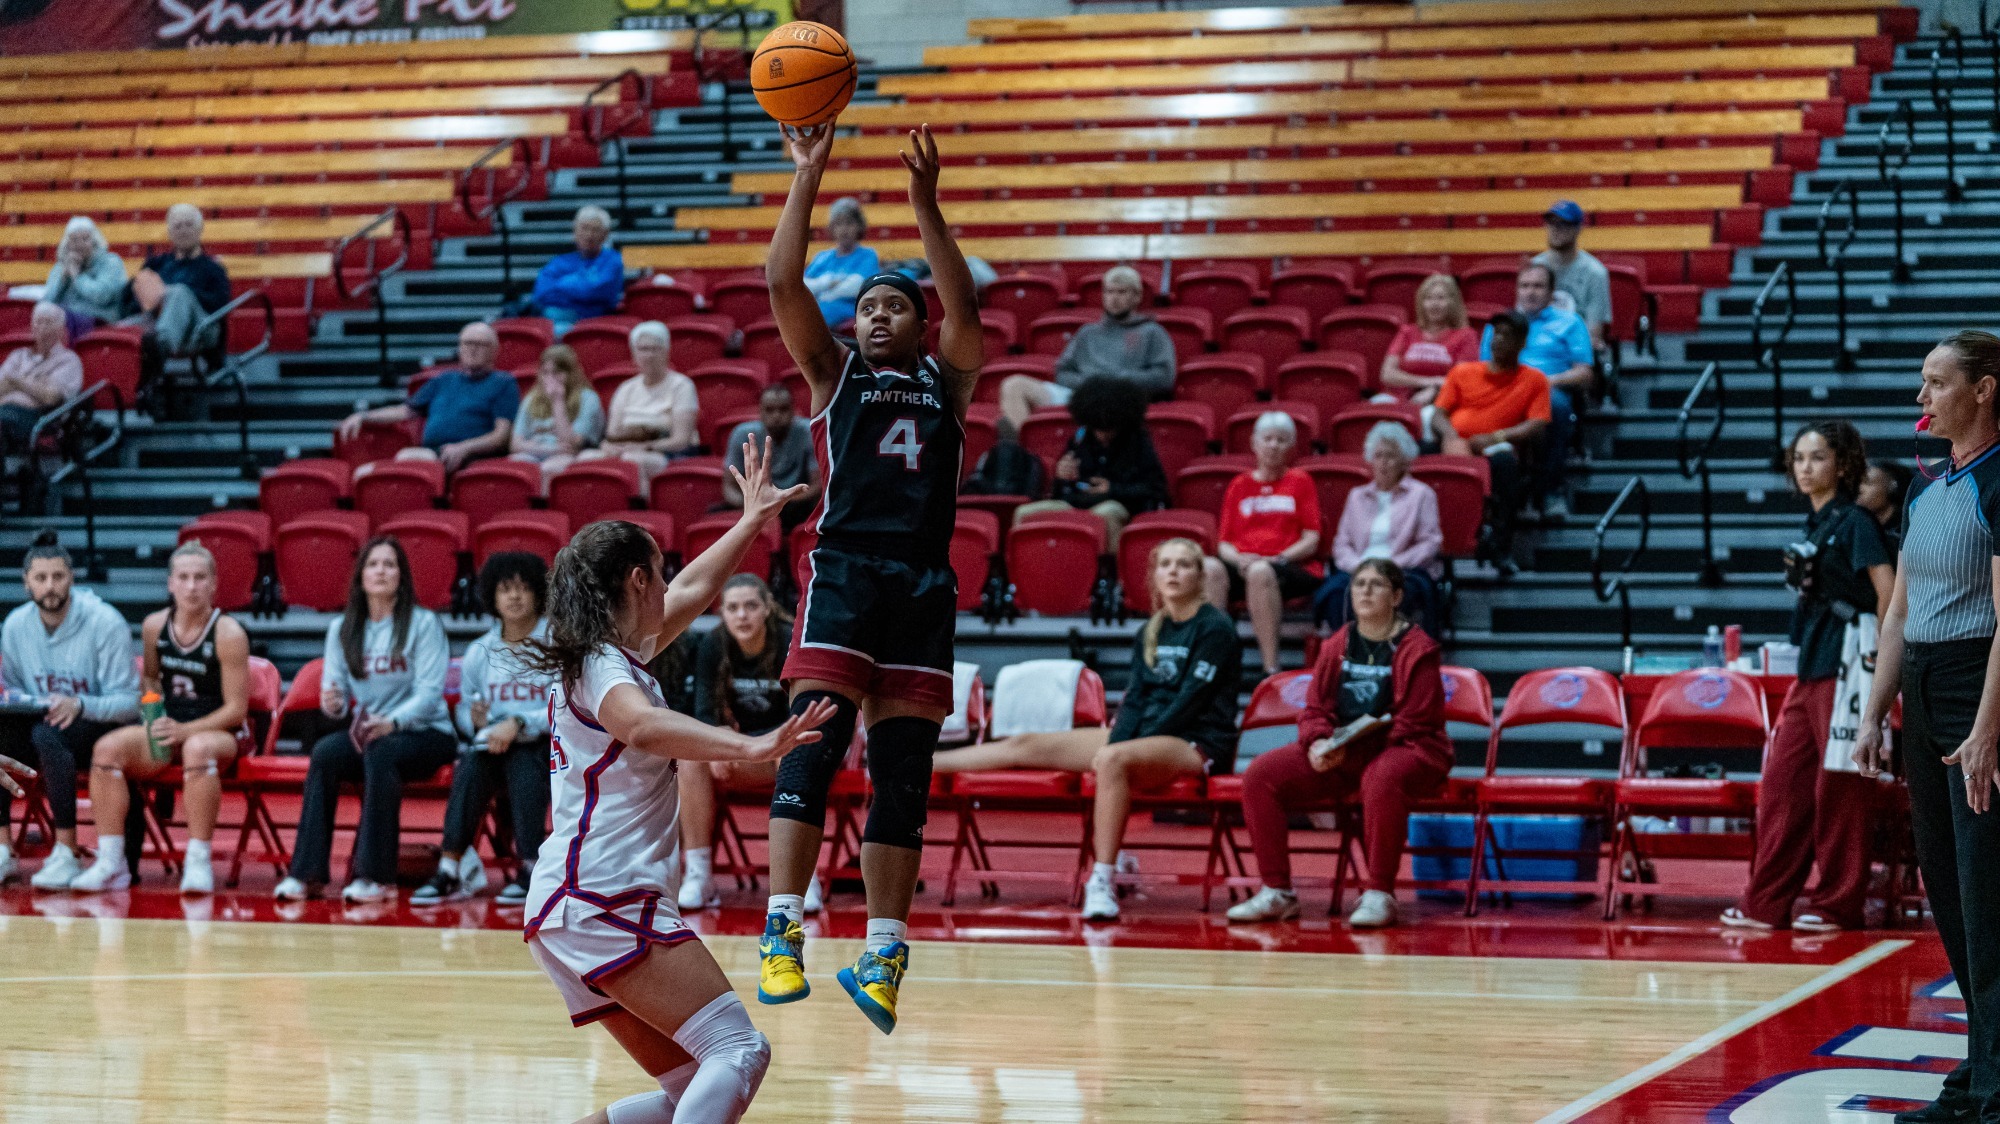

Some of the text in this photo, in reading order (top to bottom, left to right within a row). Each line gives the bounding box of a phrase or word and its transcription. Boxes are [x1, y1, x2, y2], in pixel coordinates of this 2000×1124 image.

[878, 416, 924, 472] 4
[363, 655, 408, 675] ECH
[1193, 660, 1218, 683] 21
[34, 674, 90, 697] TECH
[488, 682, 547, 702] TECH
